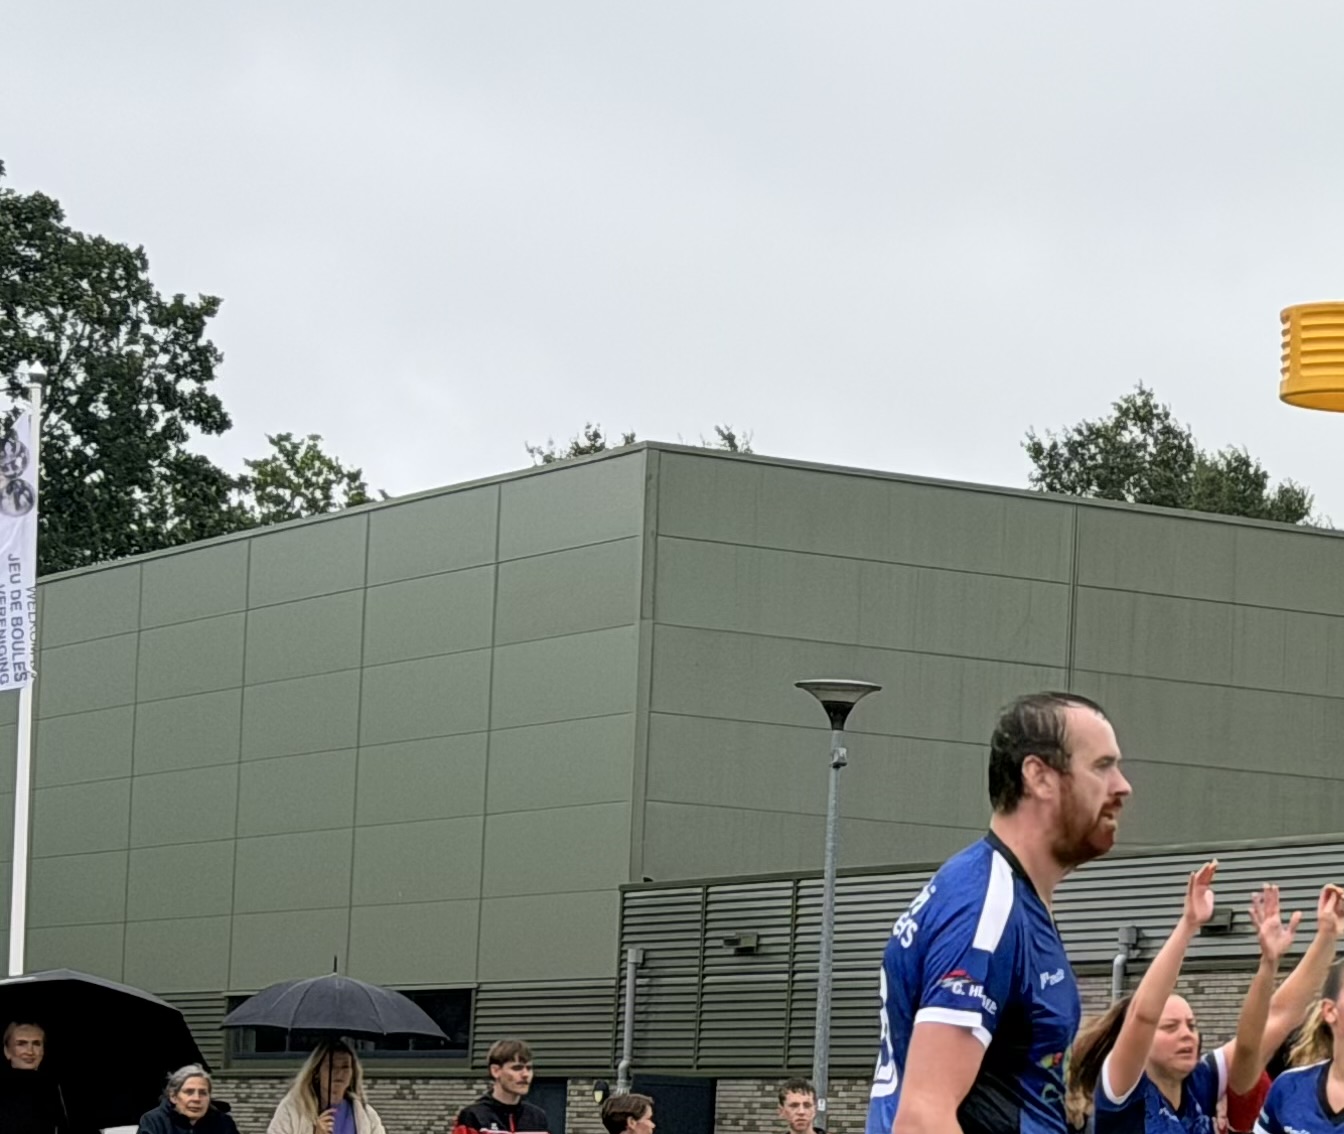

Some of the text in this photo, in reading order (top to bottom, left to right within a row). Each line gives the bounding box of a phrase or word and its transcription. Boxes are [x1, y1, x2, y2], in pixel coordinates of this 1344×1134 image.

[8, 554, 28, 683] JEU DE BOULES
